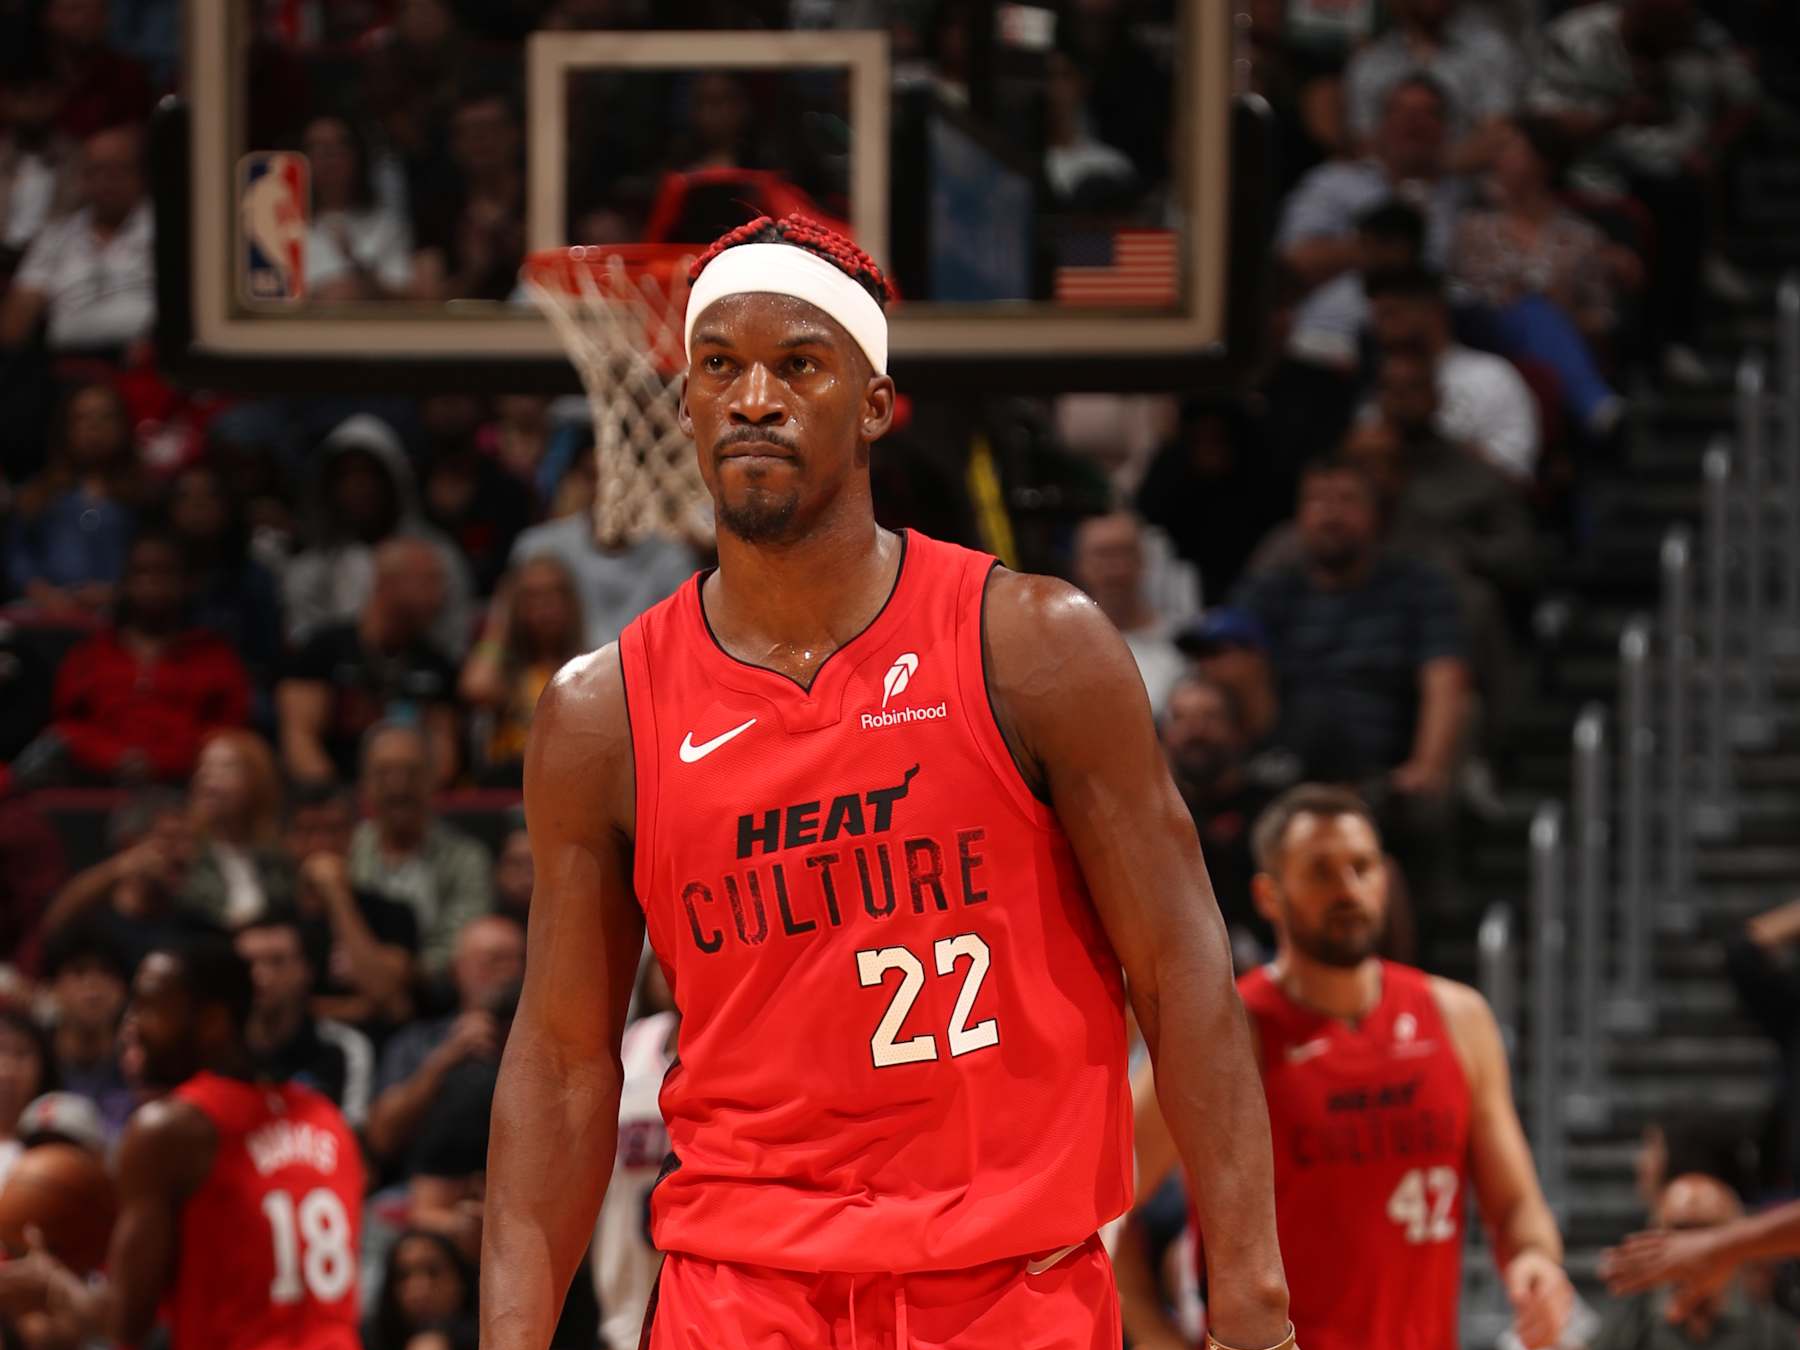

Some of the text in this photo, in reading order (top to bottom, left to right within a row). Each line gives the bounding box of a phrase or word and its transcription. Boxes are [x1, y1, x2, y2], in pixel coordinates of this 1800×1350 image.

[861, 702, 946, 729] Robinhood
[736, 764, 919, 859] HEAT
[681, 830, 988, 954] CULTURE
[856, 933, 999, 1068] 22
[262, 1188, 355, 1303] 18
[1388, 1167, 1457, 1243] 42
